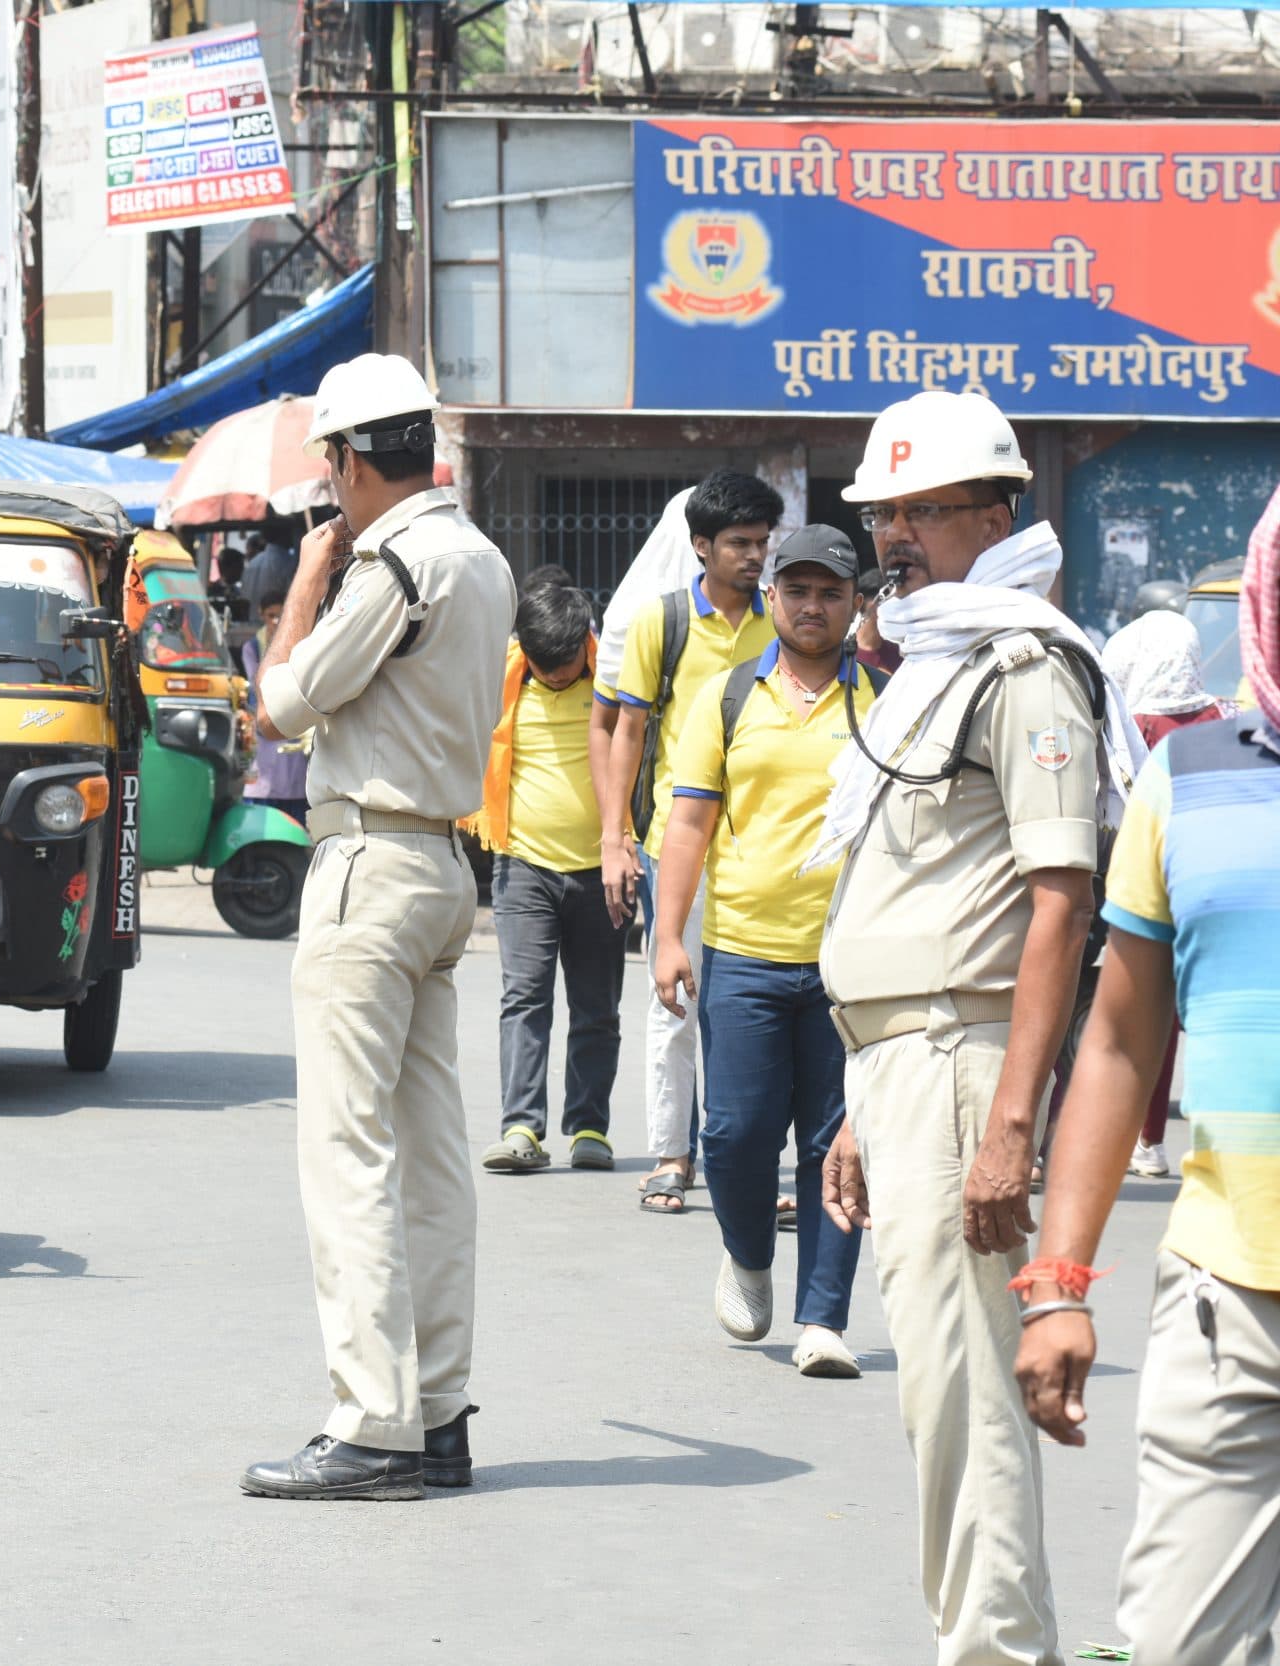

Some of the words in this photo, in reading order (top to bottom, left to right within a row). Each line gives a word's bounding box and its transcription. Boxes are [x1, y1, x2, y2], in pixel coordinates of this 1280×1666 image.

[233, 114, 273, 138] JSSC
[236, 145, 277, 167] CUET
[663, 134, 841, 196] परिचारी
[850, 151, 946, 199] प्रवर
[954, 152, 1163, 201] यातायात
[1173, 153, 1280, 202] काय
[110, 181, 194, 216] SELECTION
[196, 171, 284, 204] CLASSES
[921, 236, 1114, 309] साकची,
[773, 329, 857, 397] पूर्वी
[1050, 335, 1248, 402] जमशेदपुर
[890, 440, 912, 473] P
[115, 776, 139, 932] DINESH
